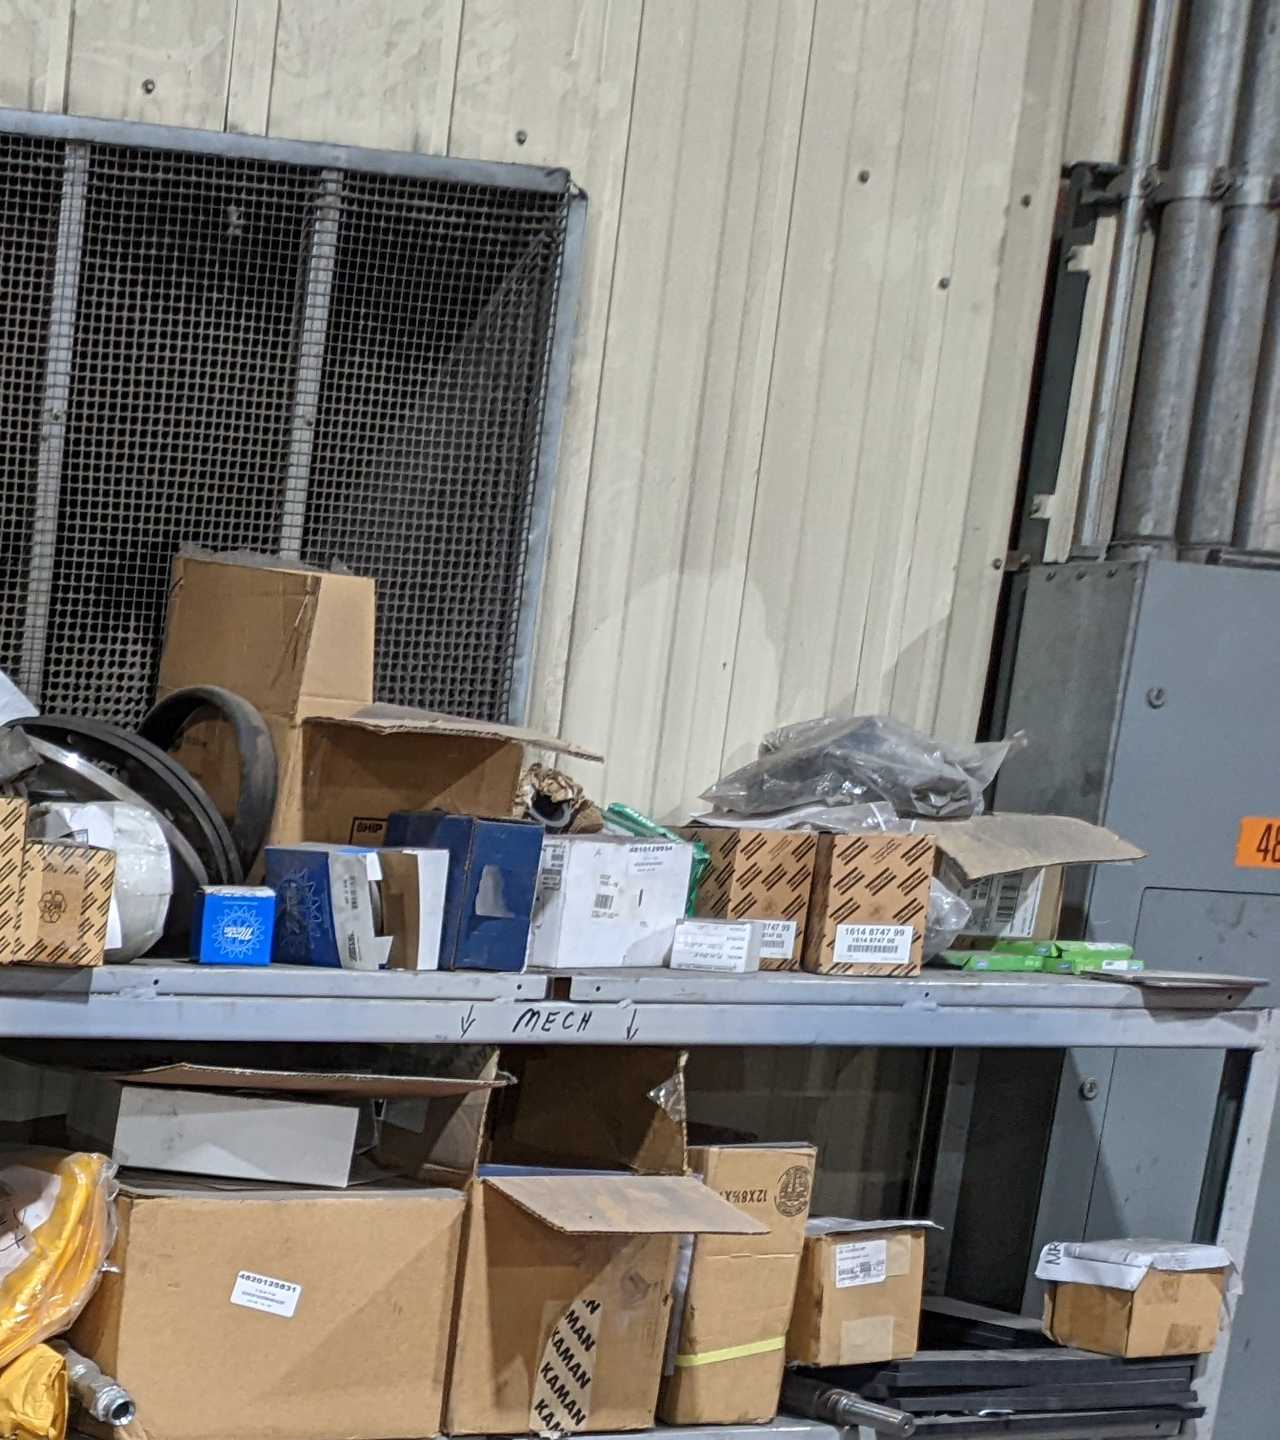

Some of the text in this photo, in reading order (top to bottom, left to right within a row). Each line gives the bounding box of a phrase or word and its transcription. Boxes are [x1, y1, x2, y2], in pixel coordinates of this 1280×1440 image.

[356, 822, 383, 834] SHIP
[512, 1008, 592, 1034] MECH
[551, 1326, 592, 1390] KAMAN
[540, 1361, 587, 1427] KAMAN
